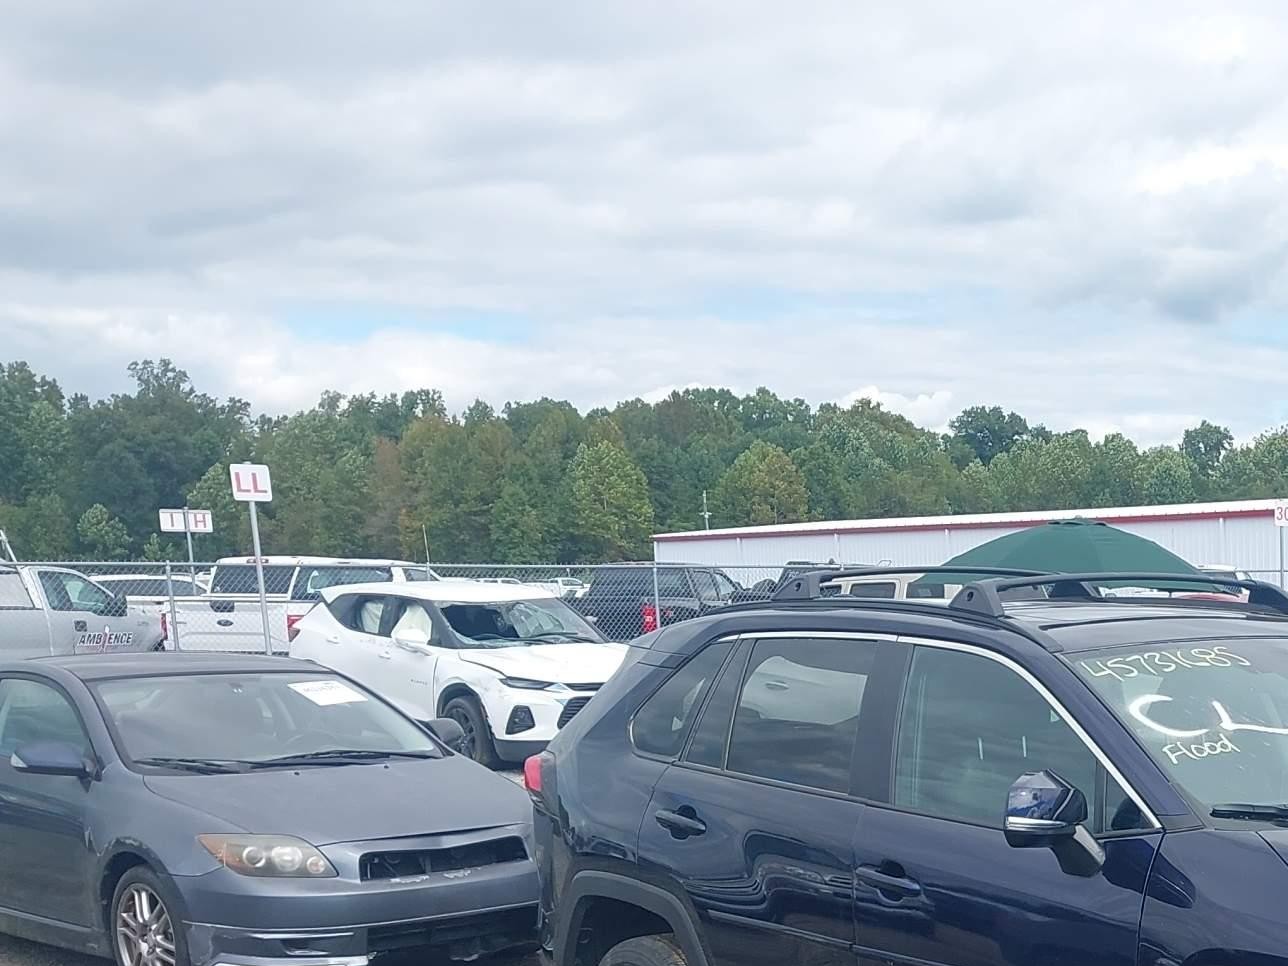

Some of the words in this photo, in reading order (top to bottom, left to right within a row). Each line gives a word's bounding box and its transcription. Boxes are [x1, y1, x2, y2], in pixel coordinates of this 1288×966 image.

[234, 471, 268, 493] LL
[193, 513, 207, 528] H
[1162, 733, 1241, 765] Flood
